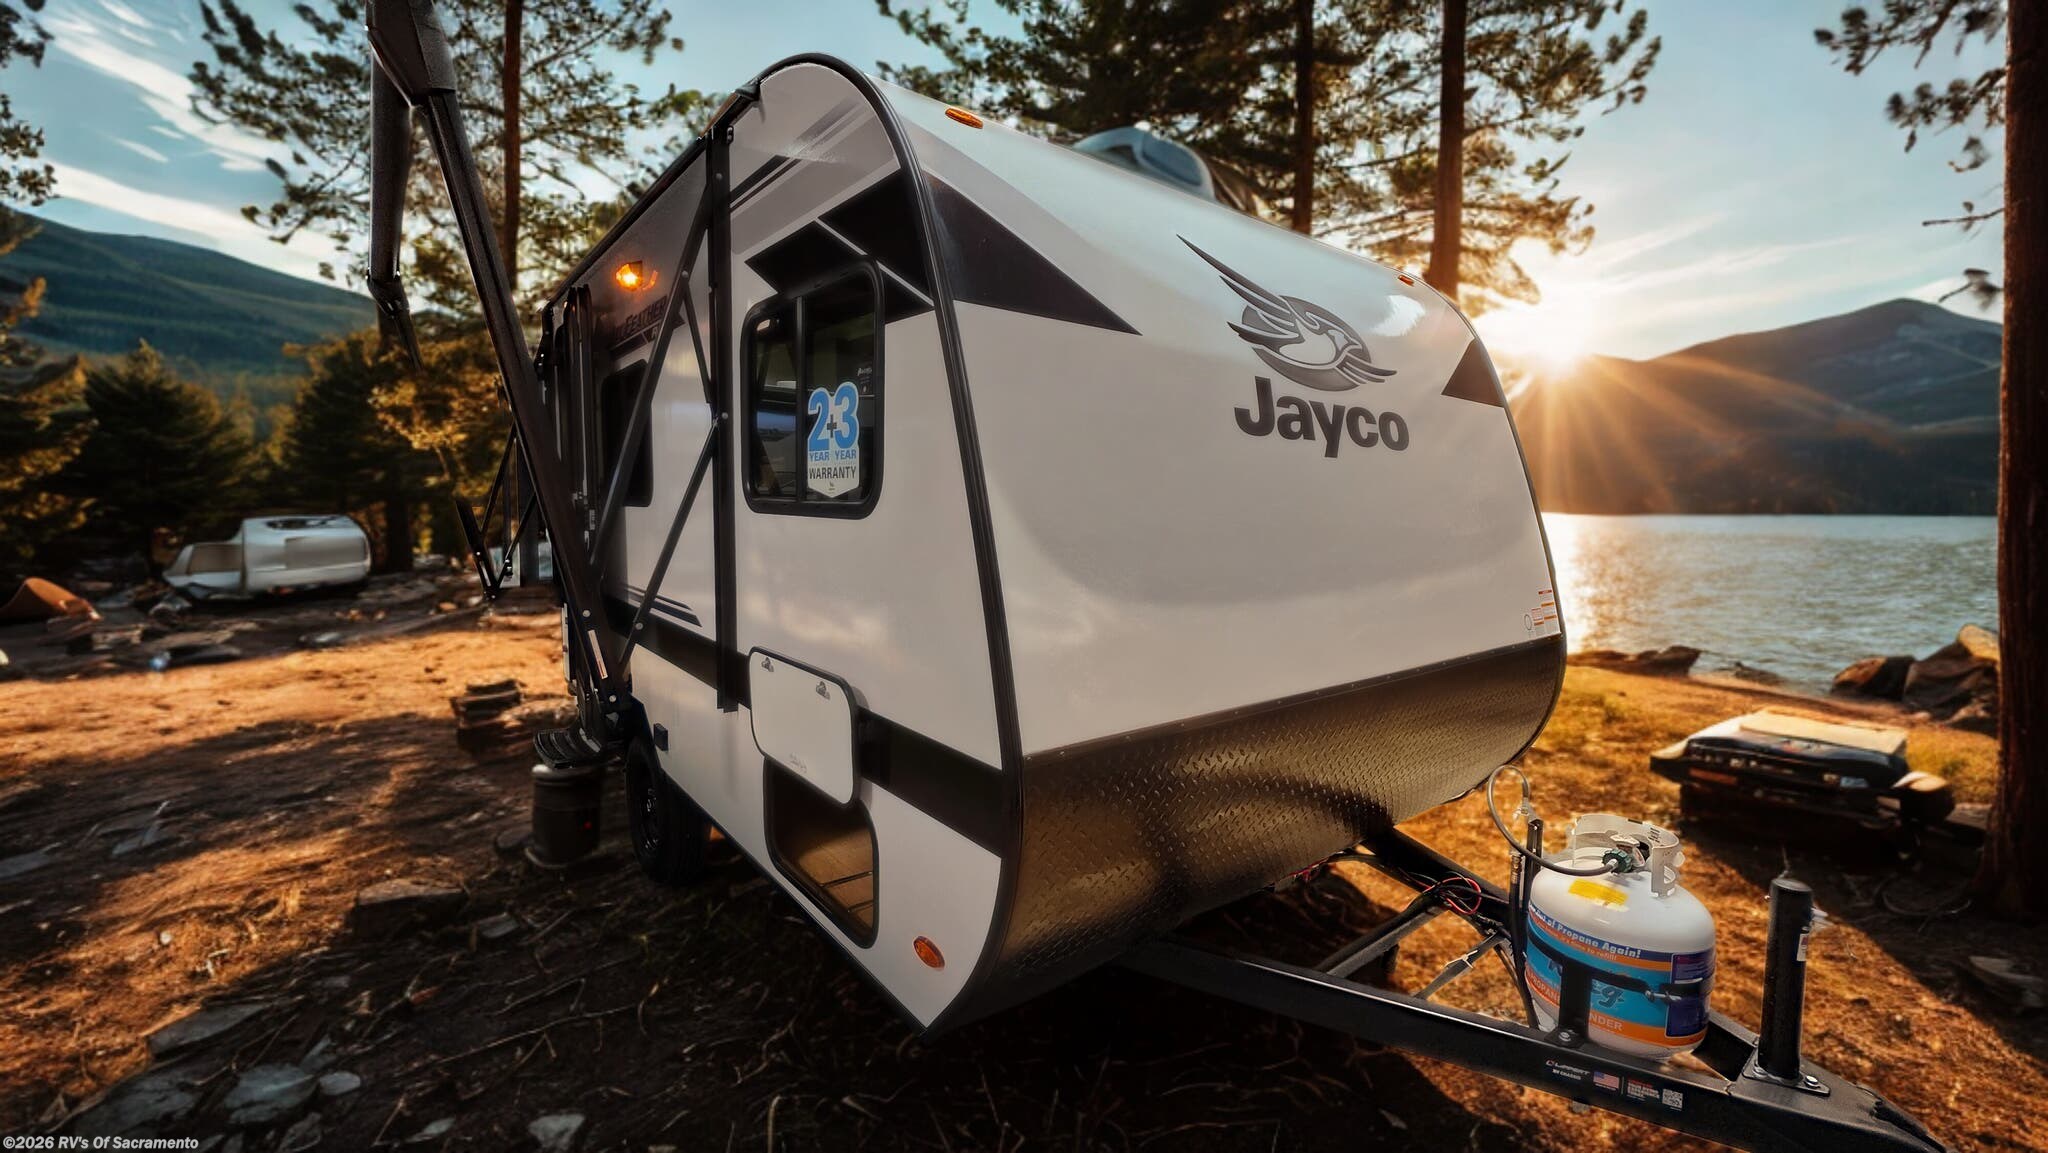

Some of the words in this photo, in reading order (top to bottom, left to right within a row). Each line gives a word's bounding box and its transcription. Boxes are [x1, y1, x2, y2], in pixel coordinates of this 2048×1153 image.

[1234, 376, 1410, 459] Jayco
[809, 451, 830, 462] YEAR
[834, 449, 857, 460] YEAR
[808, 466, 857, 480] WARRANTY
[1557, 924, 1599, 948] Propane
[1602, 942, 1641, 959] Again!
